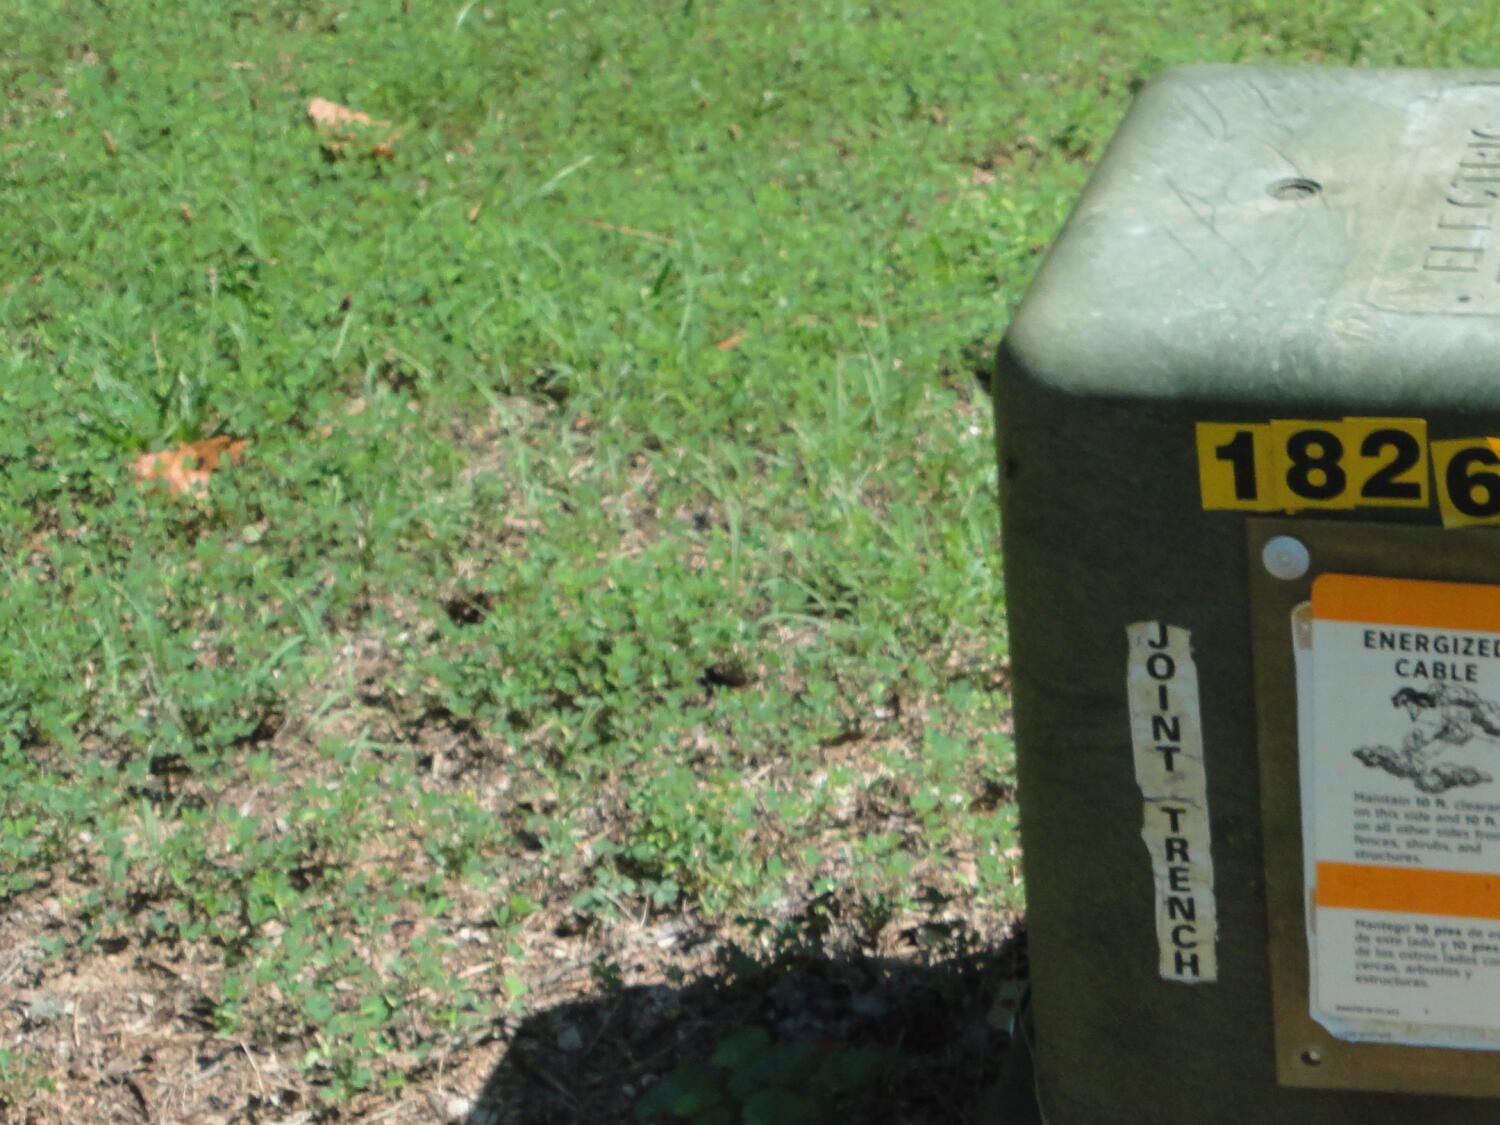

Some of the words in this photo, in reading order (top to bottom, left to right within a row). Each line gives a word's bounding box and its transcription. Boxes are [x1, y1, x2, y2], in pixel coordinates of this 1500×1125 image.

[1146, 622, 1181, 772] JOINT
[1395, 658, 1479, 683] CABLE
[1161, 806, 1200, 978] TRENCH
